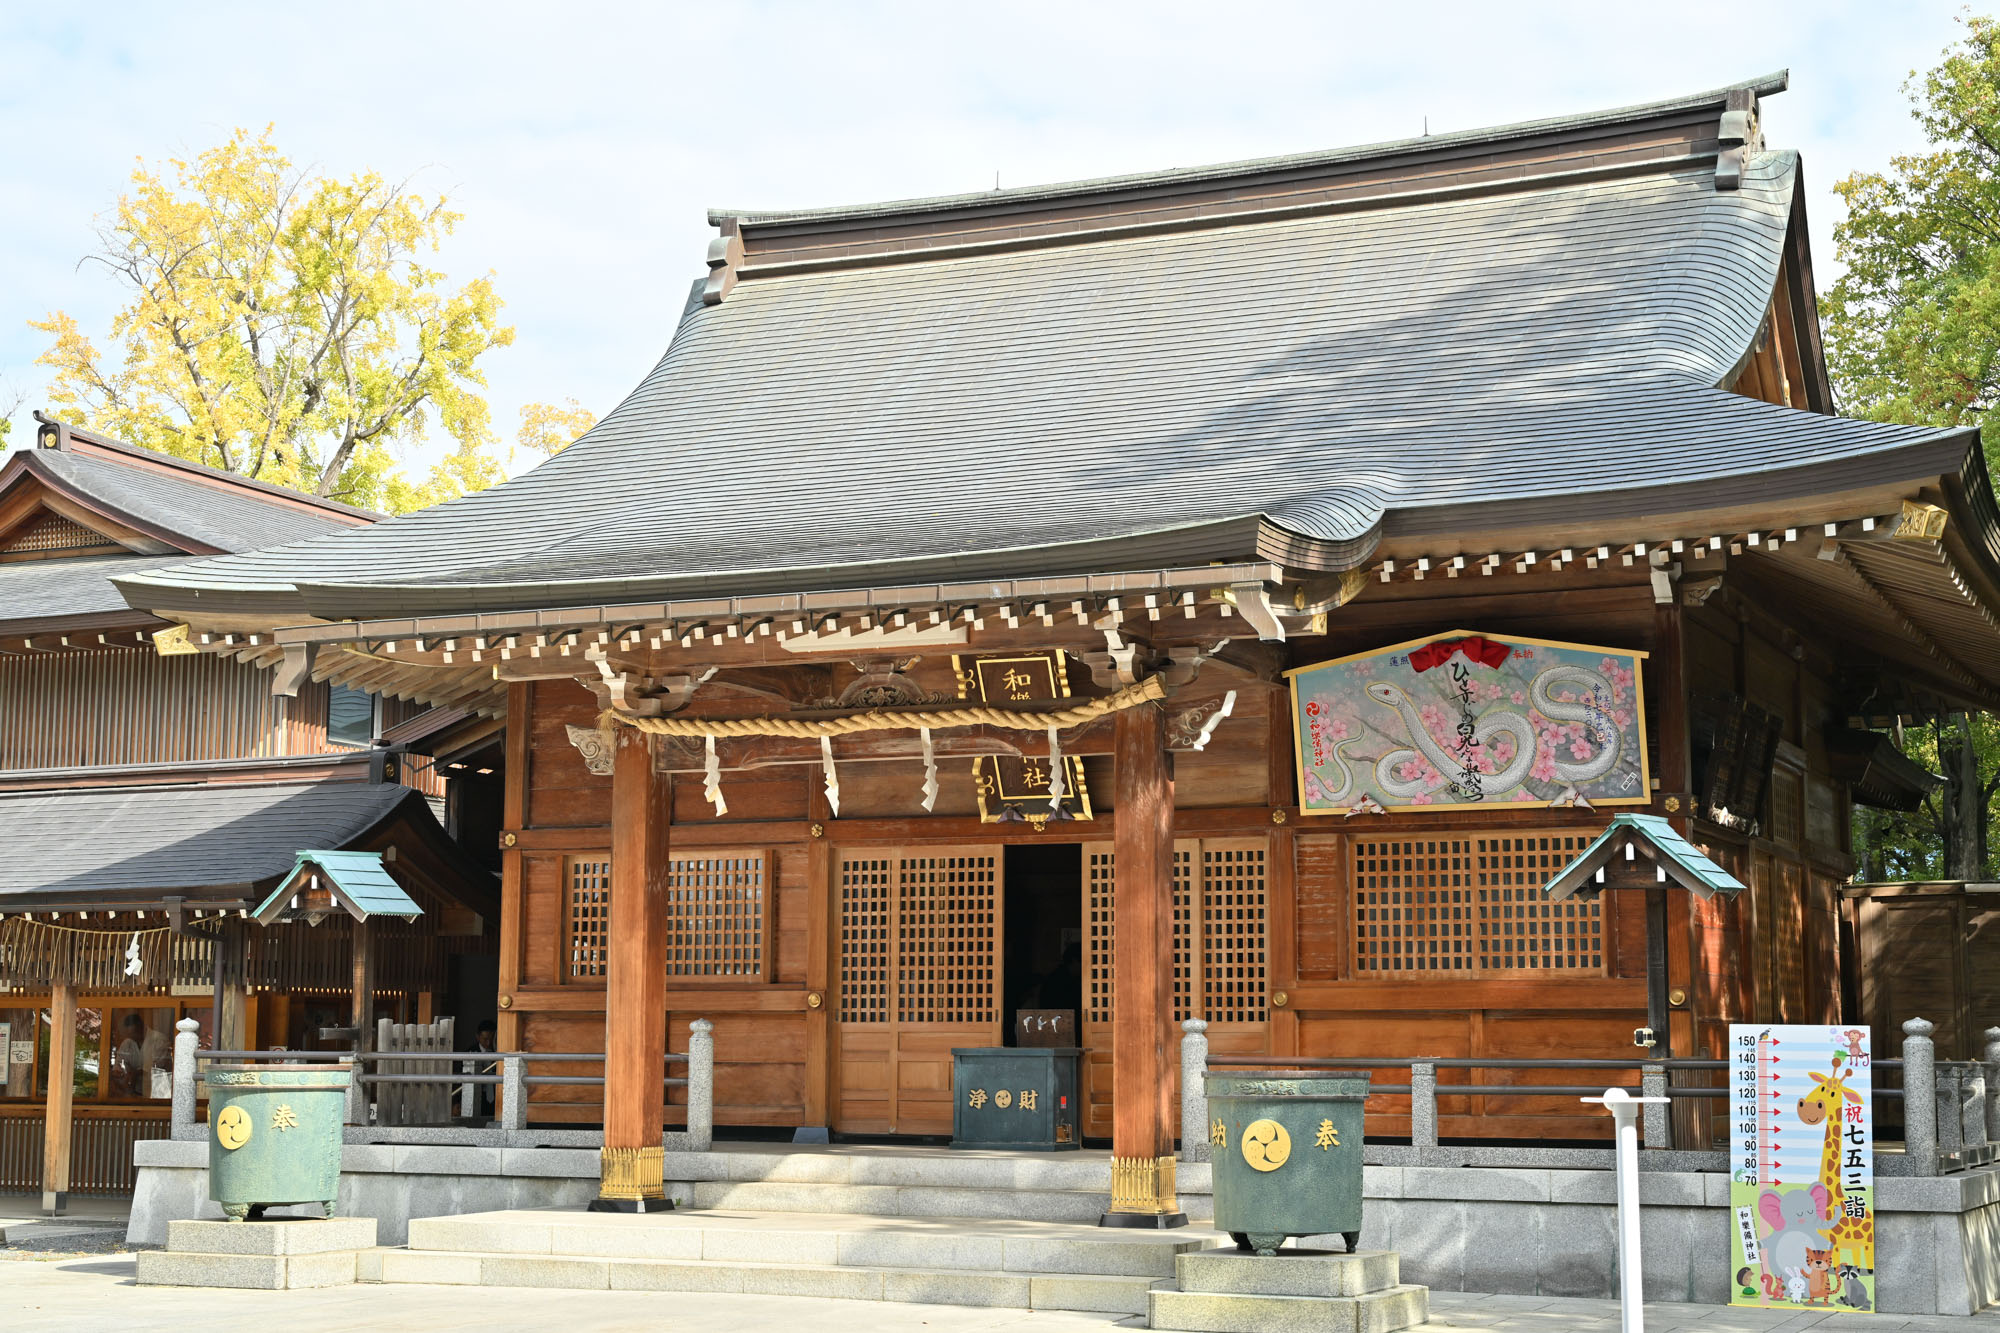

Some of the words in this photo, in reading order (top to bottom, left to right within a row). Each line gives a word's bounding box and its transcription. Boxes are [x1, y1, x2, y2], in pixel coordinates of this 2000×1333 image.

[1738, 1036, 1756, 1046] 150
[1738, 1053, 1756, 1064] 140
[1739, 1070, 1756, 1081] 130
[1739, 1088, 1756, 1099] 120
[1739, 1105, 1756, 1116] 110
[271, 1104, 299, 1132] 奉
[1211, 1117, 1227, 1148] 納
[1739, 1123, 1756, 1134] 100
[1314, 1118, 1341, 1151] 奉
[1744, 1141, 1757, 1151] 90
[1745, 1158, 1757, 1169] 80
[1844, 1103, 1866, 1219] 祝七五三詣
[1745, 1175, 1757, 1187] 70
